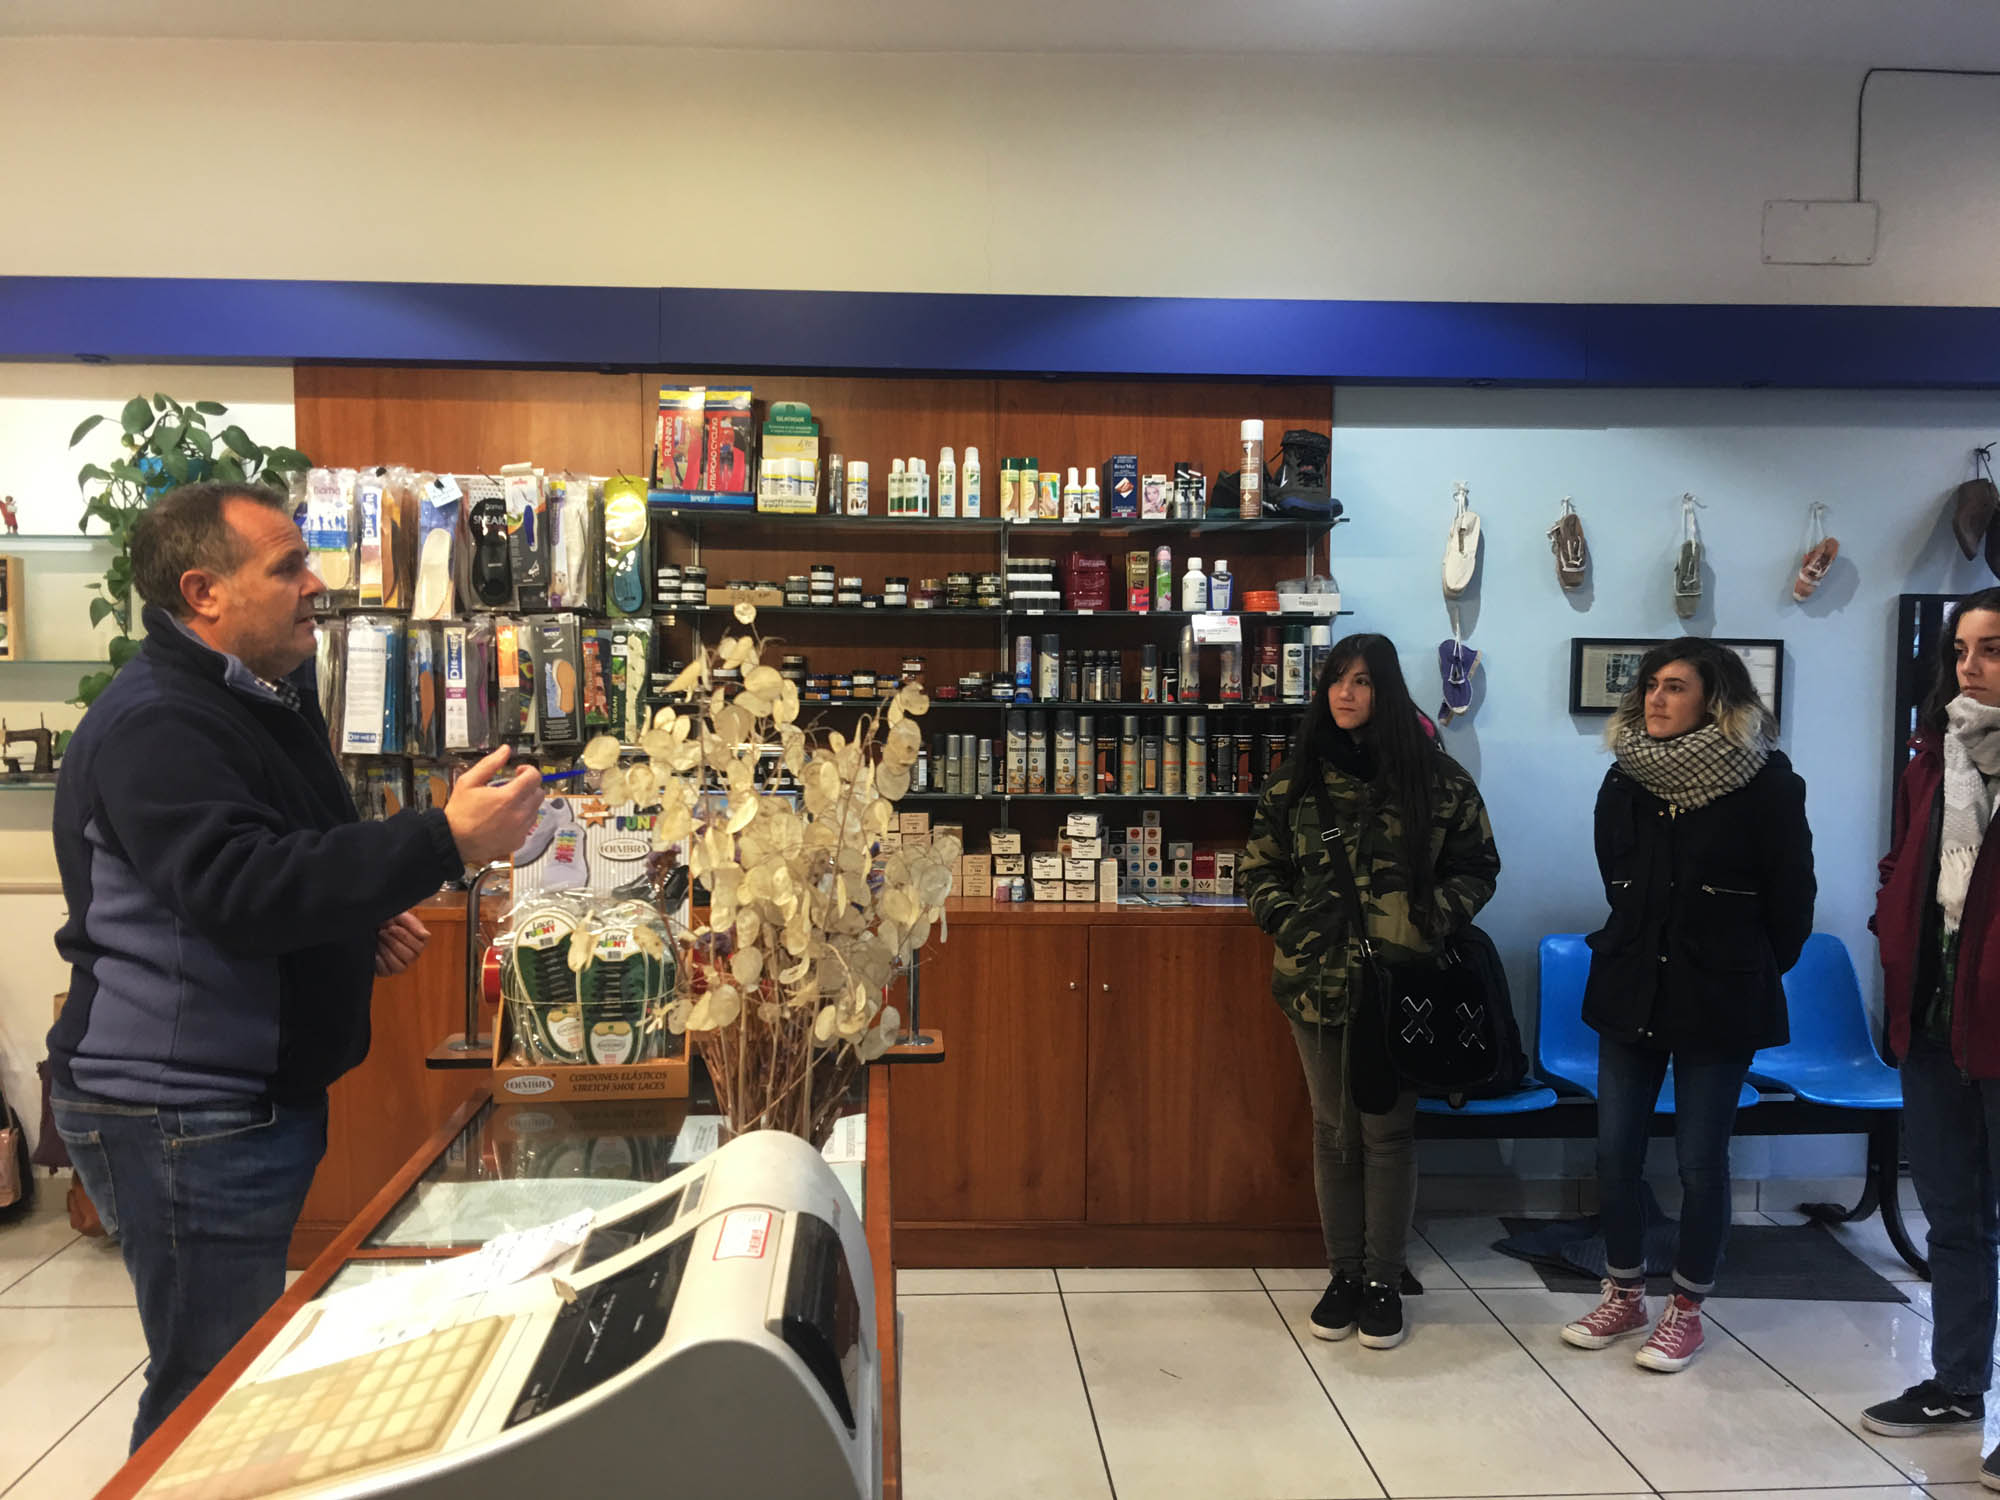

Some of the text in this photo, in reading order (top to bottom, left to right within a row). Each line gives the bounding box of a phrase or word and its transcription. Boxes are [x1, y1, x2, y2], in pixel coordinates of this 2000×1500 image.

[664, 416, 673, 457] RUNNING
[525, 925, 555, 938] FUNNY
[569, 1072, 619, 1082] CORDONES
[572, 1081, 665, 1093] STRETCH SHOE LACES
